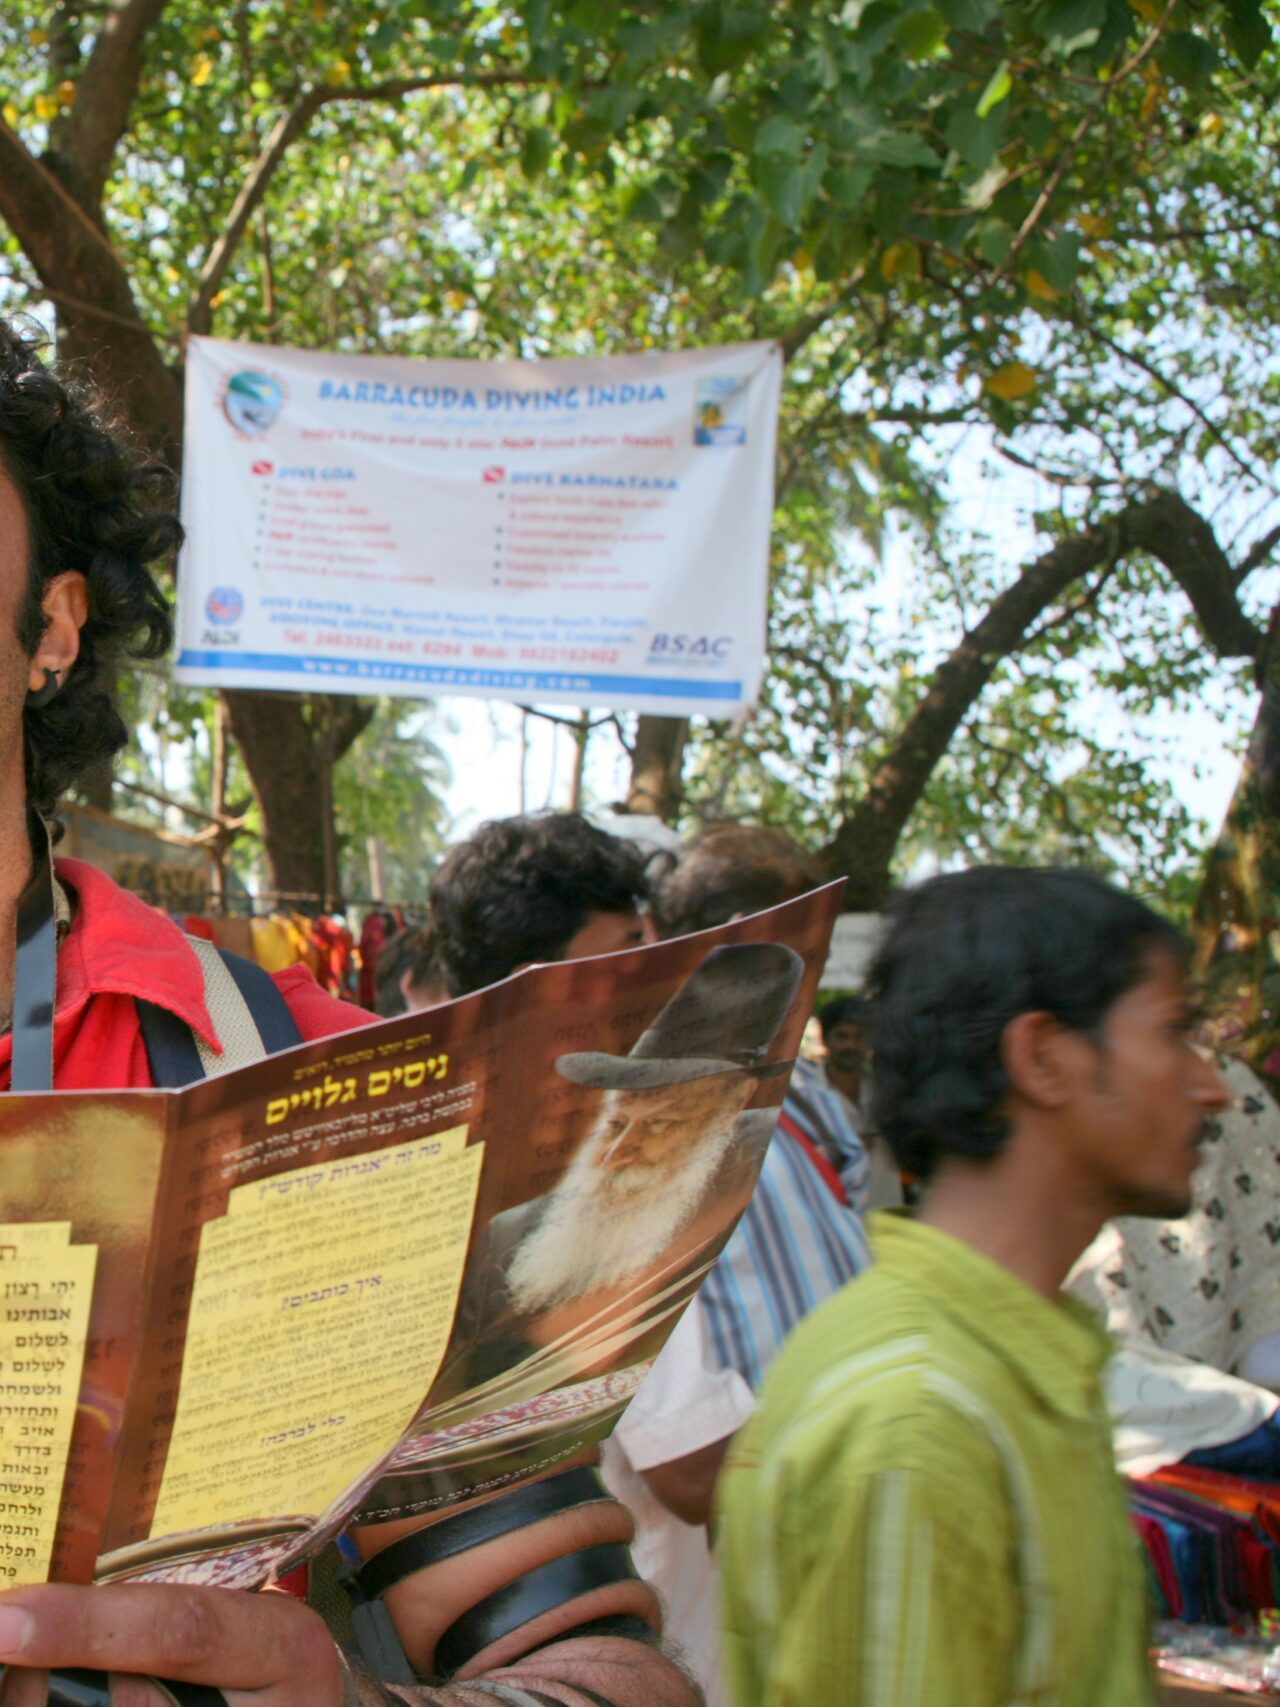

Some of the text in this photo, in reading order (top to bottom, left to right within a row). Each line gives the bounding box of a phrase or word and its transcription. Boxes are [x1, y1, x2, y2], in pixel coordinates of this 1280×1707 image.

[318, 380, 668, 411] BARRACUDA DIVING INDIA
[650, 632, 732, 658] BSAC
[265, 1054, 449, 1124] ניסים גלויים
[355, 1273, 382, 1293] איך
